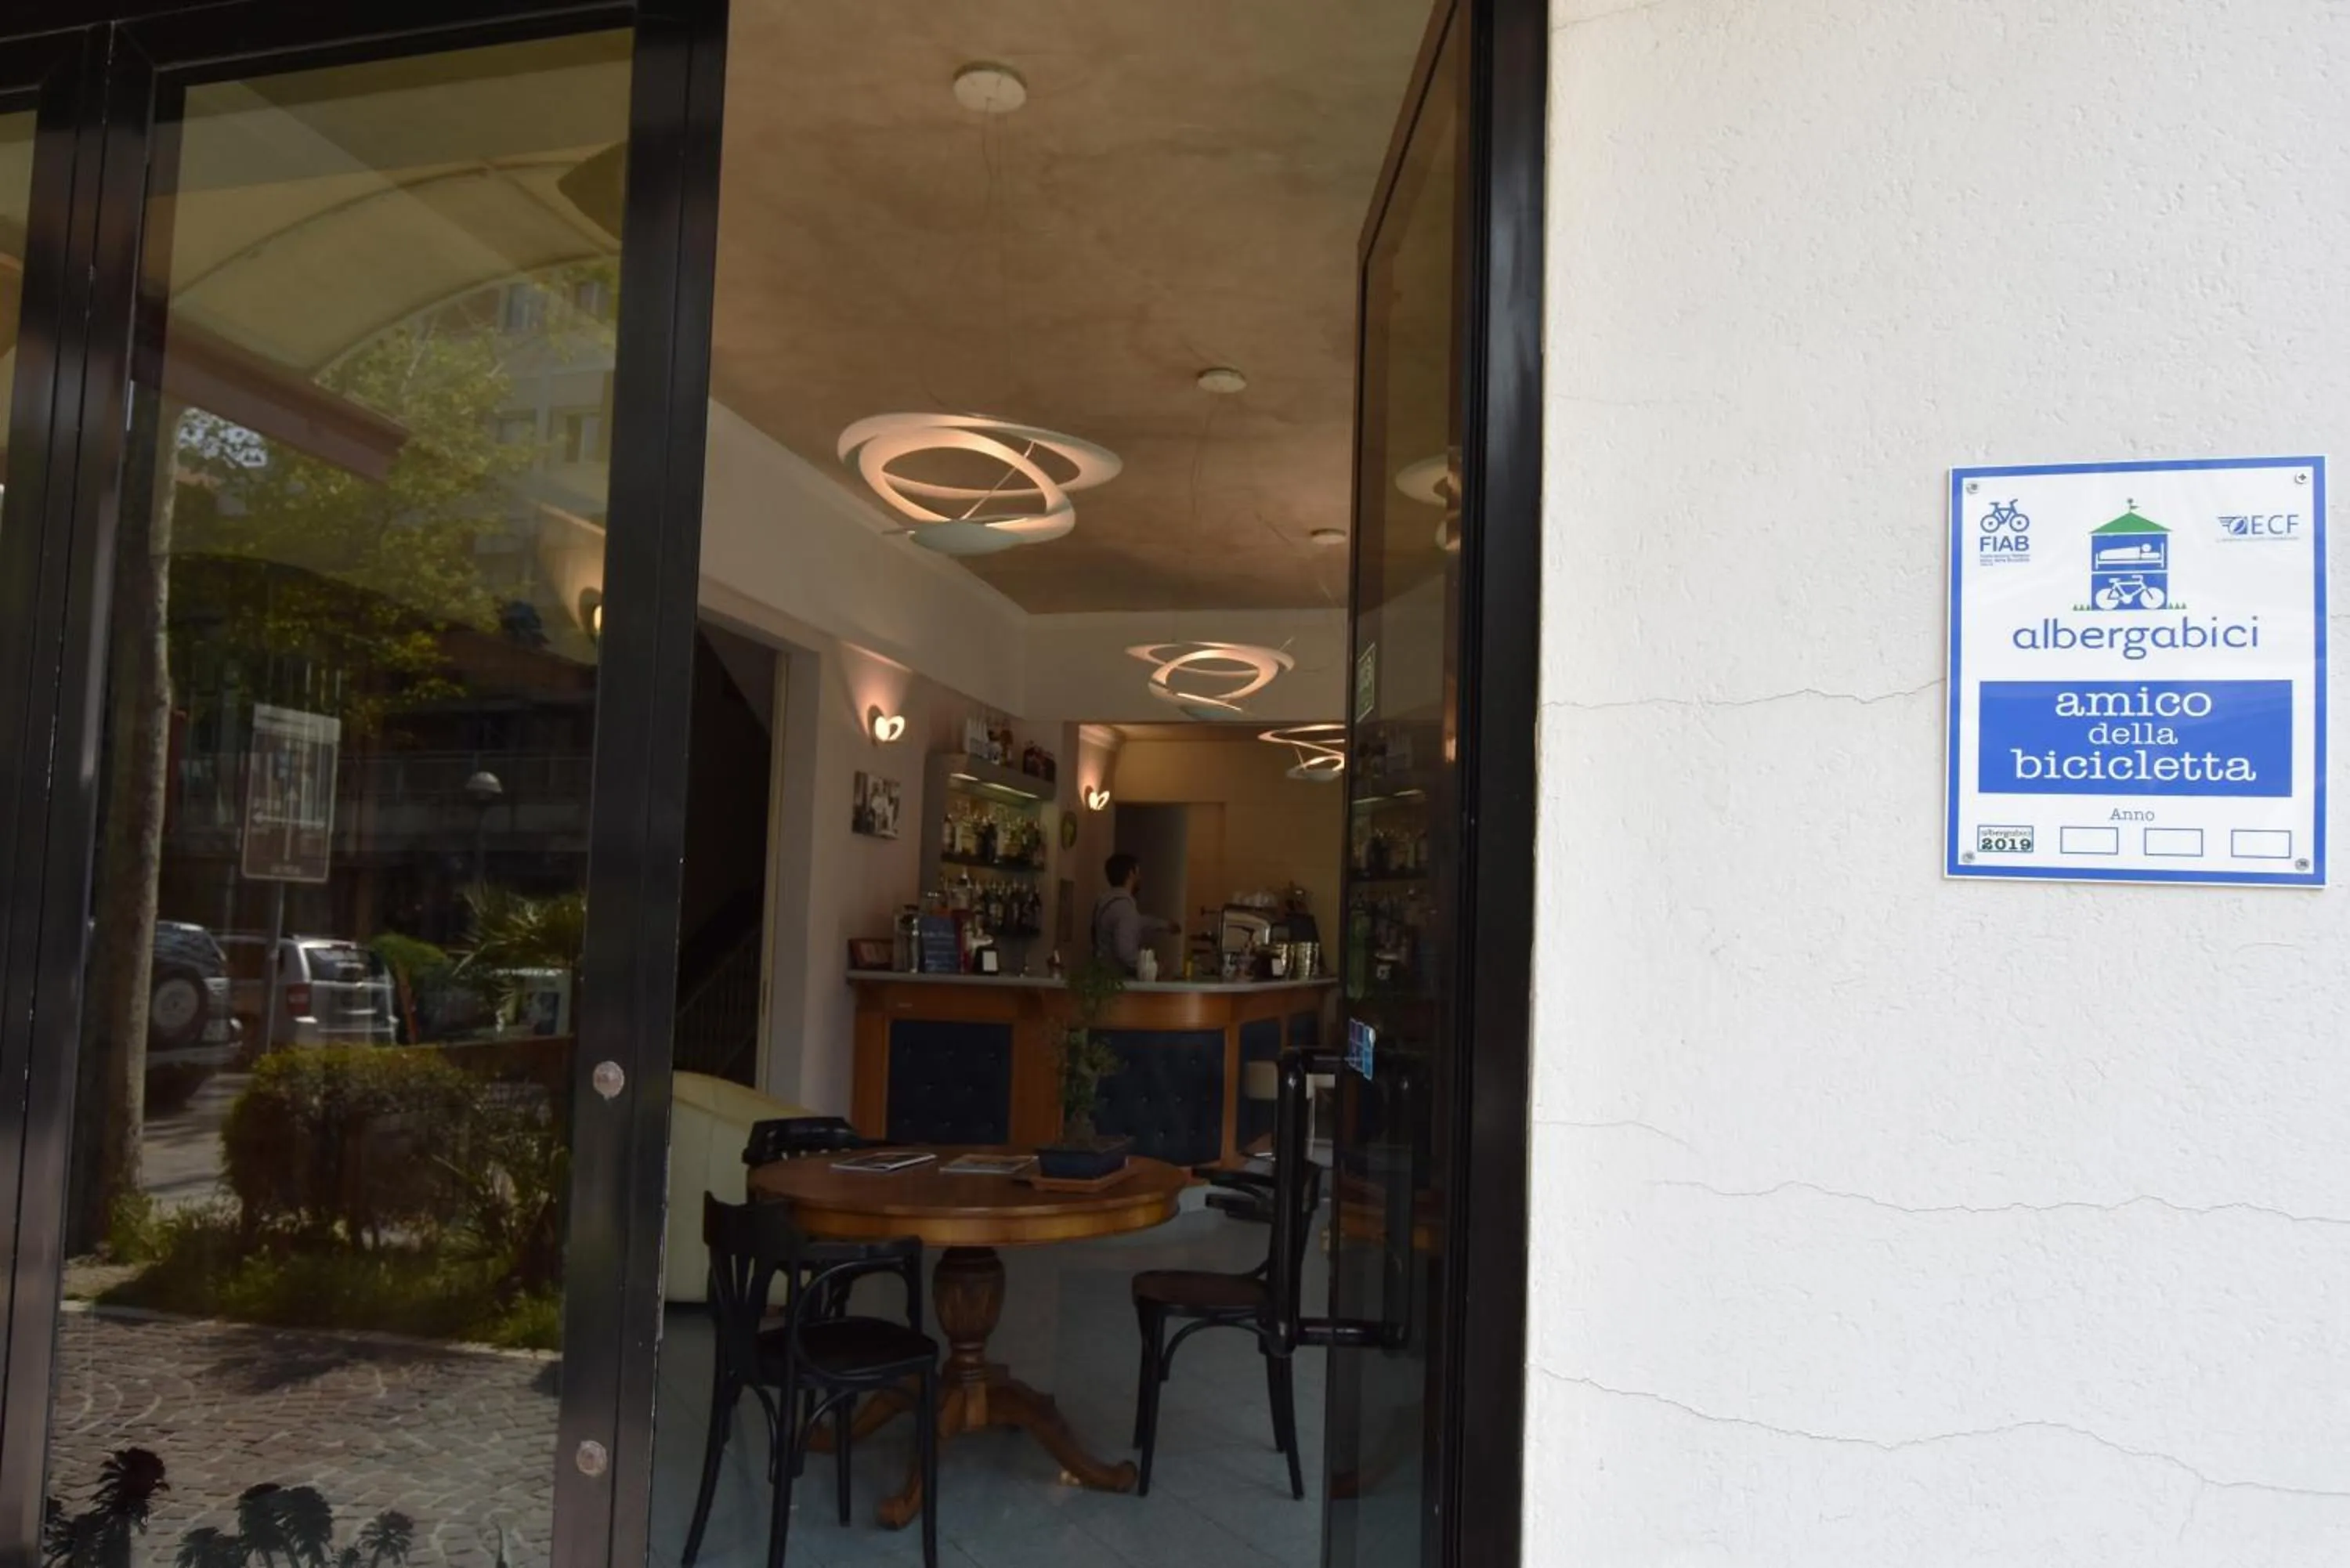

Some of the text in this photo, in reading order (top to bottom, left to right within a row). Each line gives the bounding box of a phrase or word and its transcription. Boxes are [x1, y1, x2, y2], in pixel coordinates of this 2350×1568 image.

[2251, 514, 2299, 535] ECF
[1979, 536, 2030, 552] FIAB
[2012, 616, 2259, 660] albergabici
[2055, 687, 2213, 718] amico
[2088, 723, 2178, 746] della
[2011, 750, 2257, 782] bicicletta
[2110, 808, 2155, 822] Anno
[1981, 837, 2031, 851] 2019
